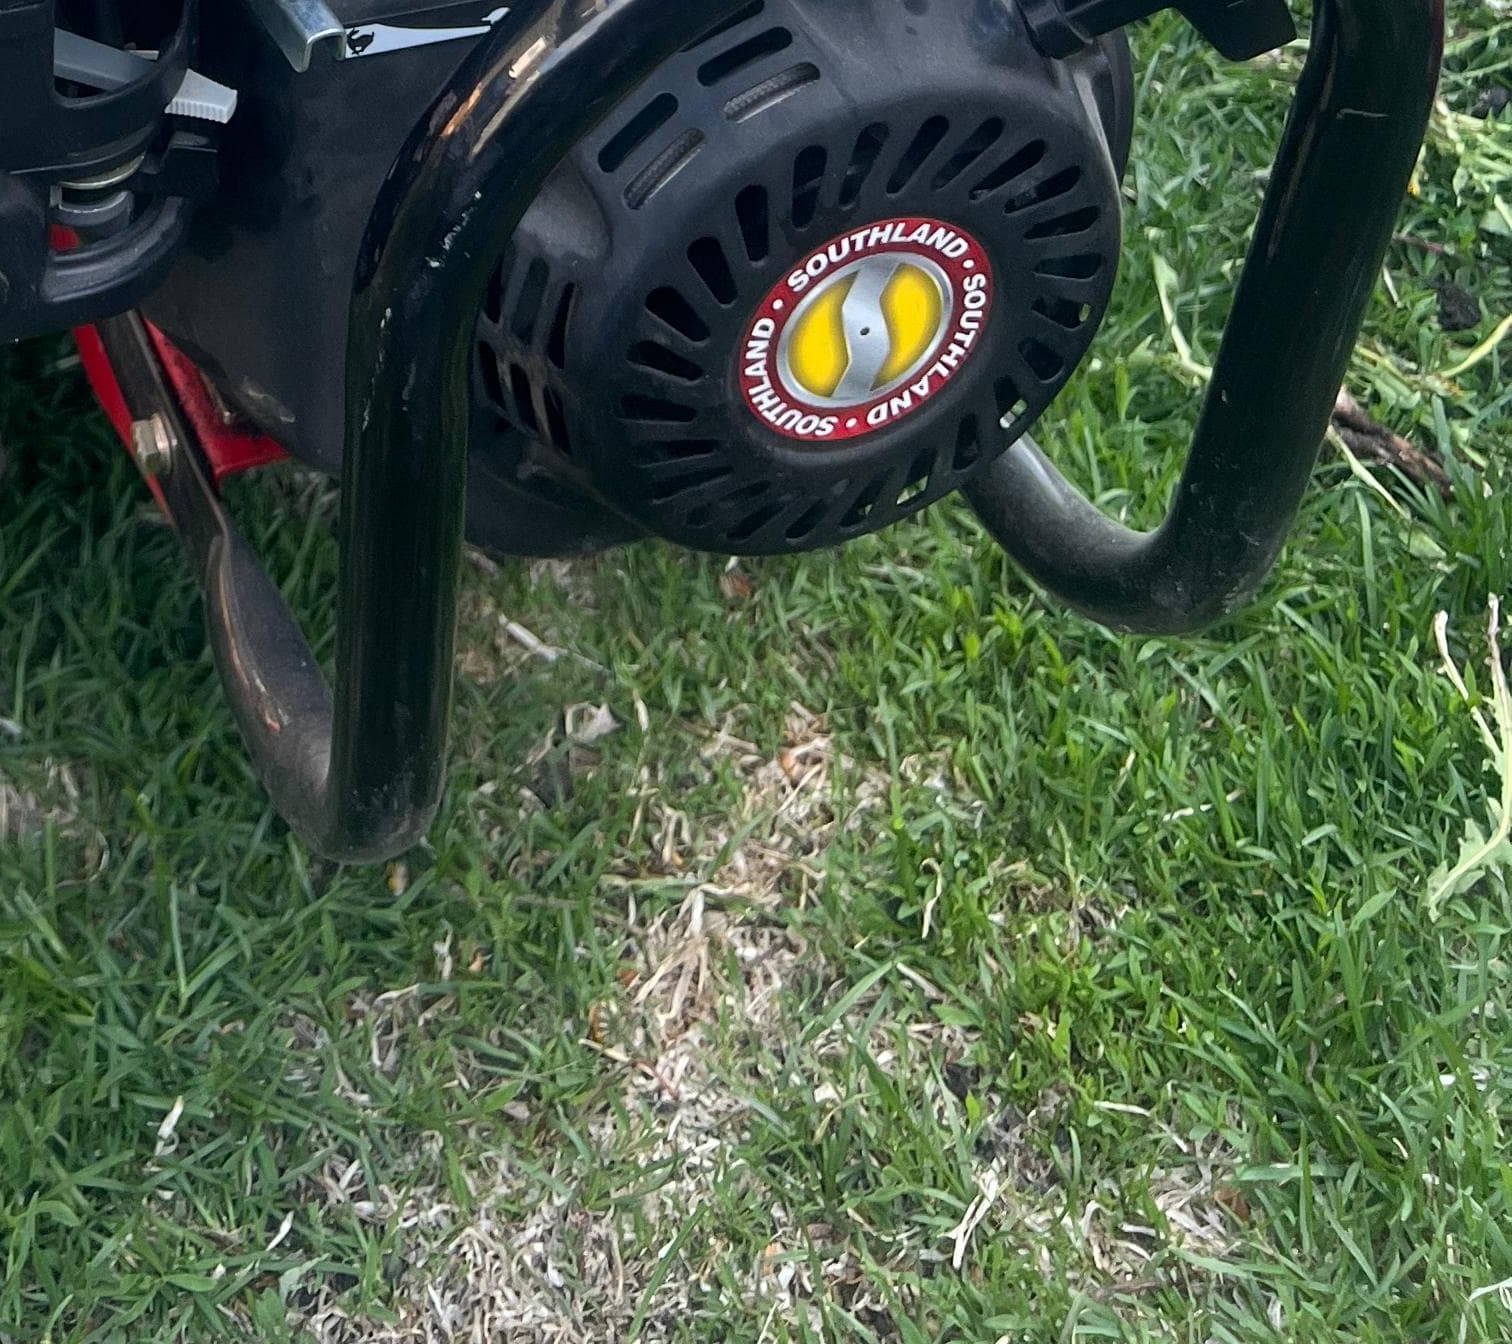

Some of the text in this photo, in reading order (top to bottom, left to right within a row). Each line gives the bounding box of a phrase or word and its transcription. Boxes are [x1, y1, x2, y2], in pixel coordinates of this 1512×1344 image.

[788, 222, 969, 292] SOUTHLAND
[744, 317, 839, 437] SOUTHLAND
[866, 272, 986, 427] SOUTHLAND
